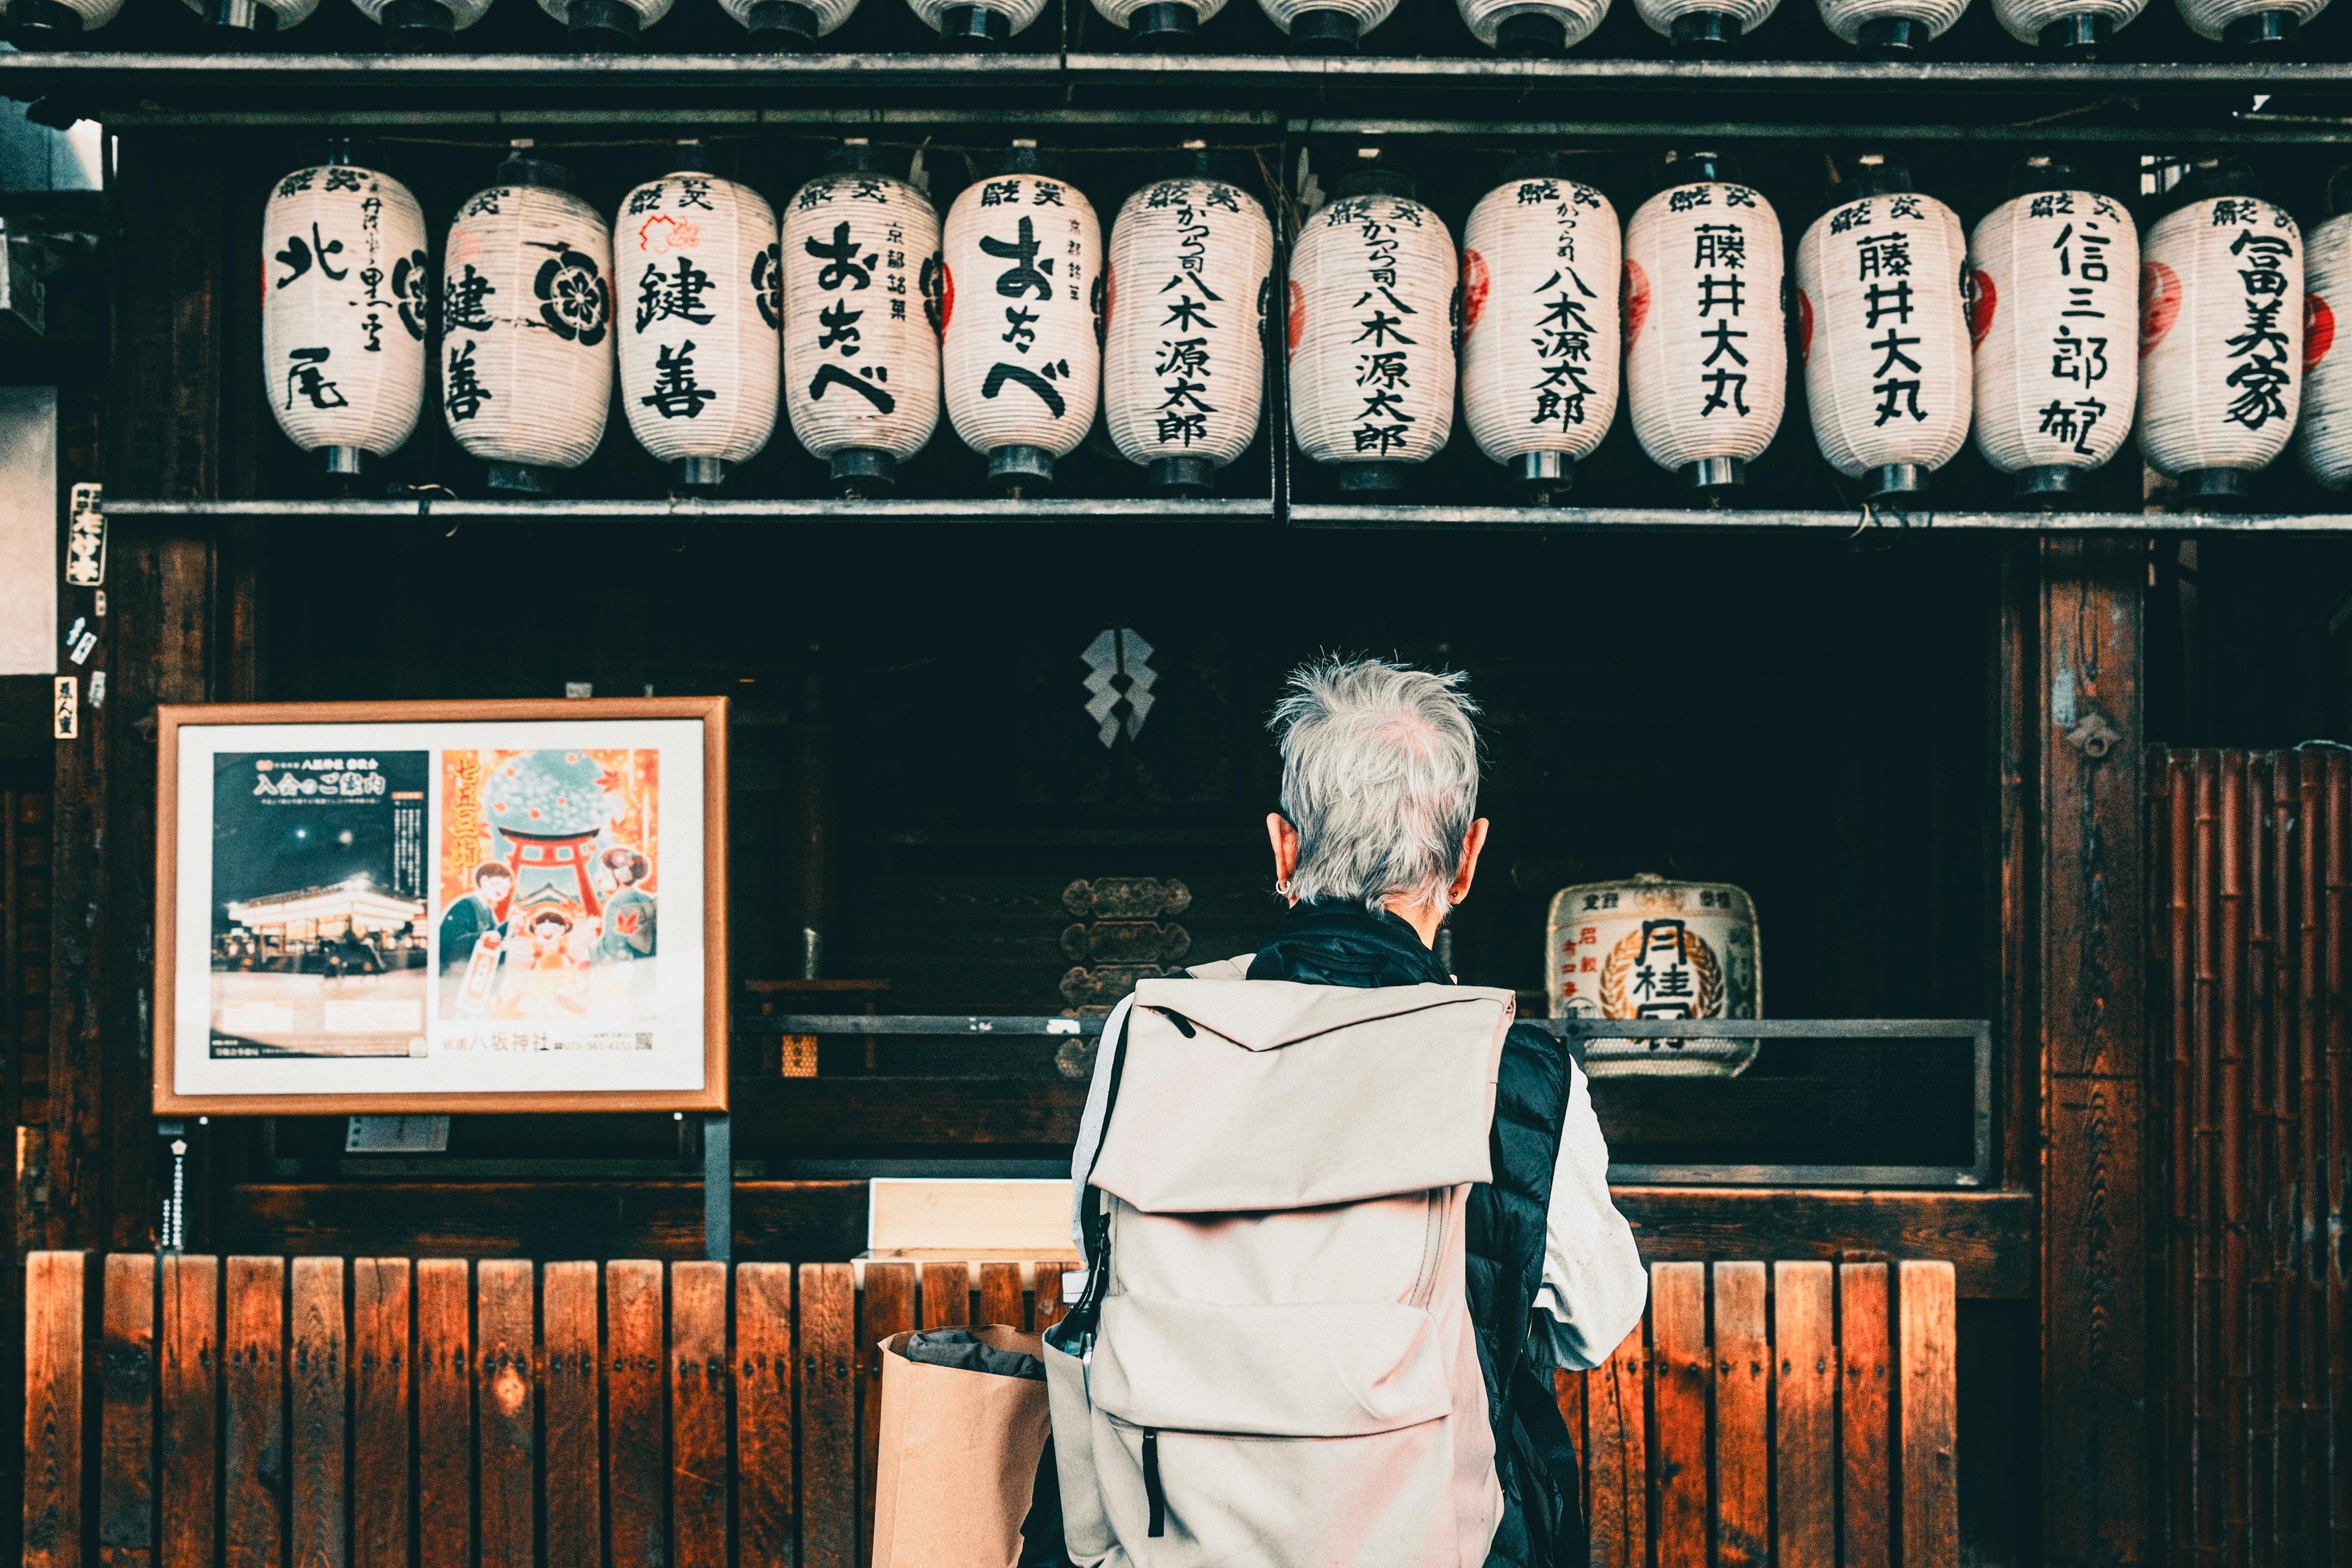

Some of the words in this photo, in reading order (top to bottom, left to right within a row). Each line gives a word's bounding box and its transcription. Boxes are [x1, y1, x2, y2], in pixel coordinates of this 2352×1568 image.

[276, 222, 349, 410] 北尾
[635, 256, 715, 419] 鍵善
[884, 221, 907, 322] 京都銘菓
[1694, 224, 1750, 417] 藤井大丸
[1856, 232, 1928, 428] 藤井大丸
